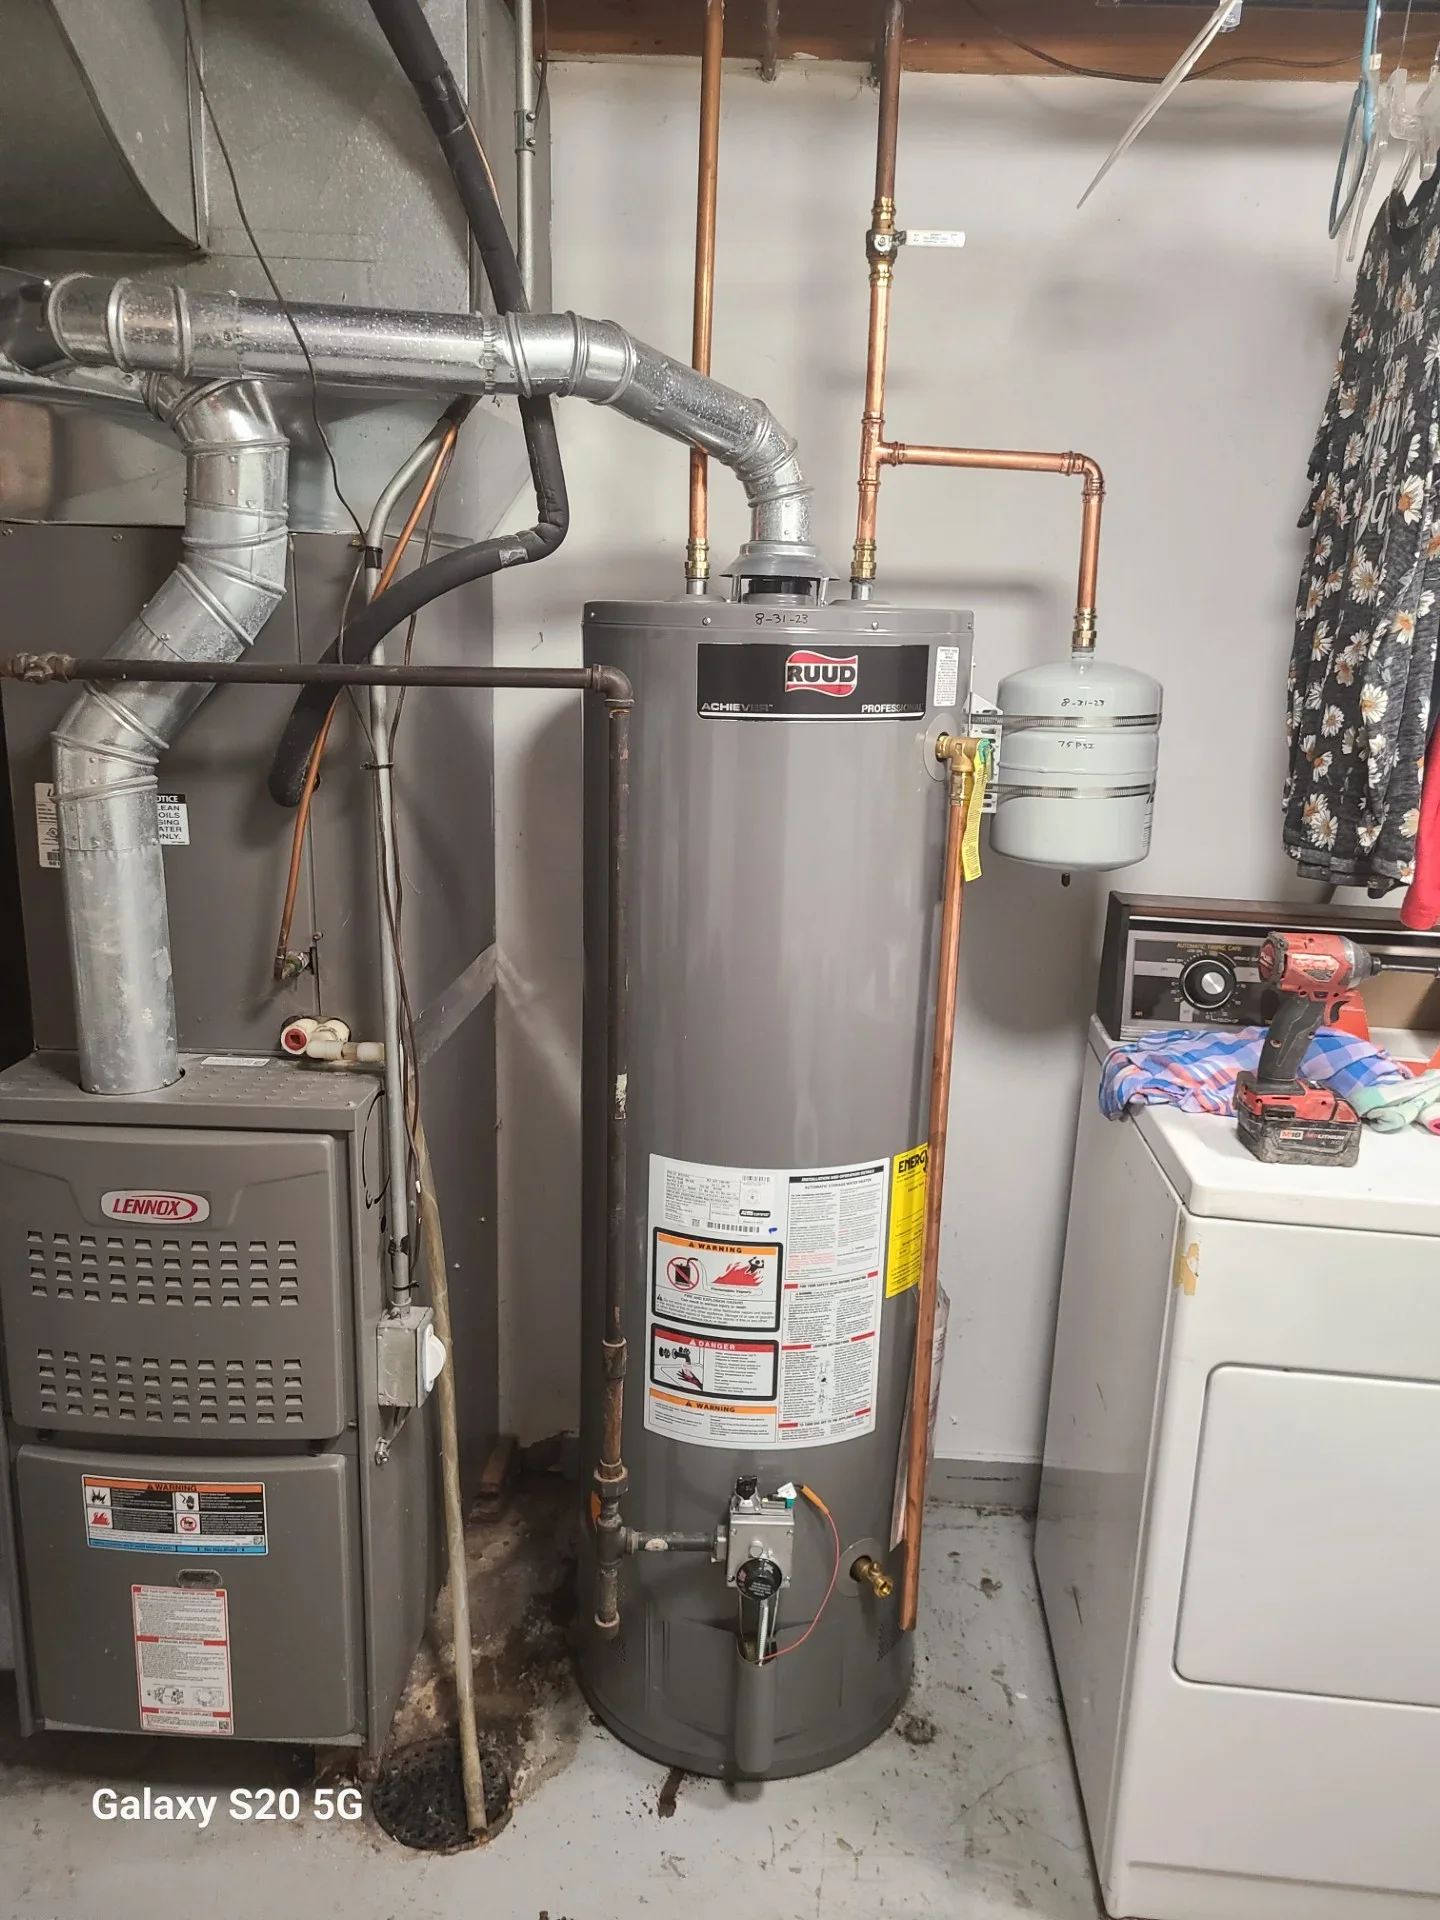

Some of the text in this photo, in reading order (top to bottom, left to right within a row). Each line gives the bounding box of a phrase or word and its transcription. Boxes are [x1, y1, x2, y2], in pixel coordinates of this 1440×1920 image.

[754, 612, 809, 625] 8-31-23
[787, 664, 856, 683] RUUD
[1060, 697, 1105, 708] 8-31-23
[1058, 740, 1095, 750] 75 PSI
[156, 795, 179, 803] OTICE
[158, 811, 181, 819] OILS
[112, 1198, 181, 1216] LENNOX
[698, 1243, 743, 1254] WARNING
[698, 1340, 736, 1350] DANGER
[696, 1402, 736, 1413] WARNING
[154, 1483, 198, 1492] WARNING
